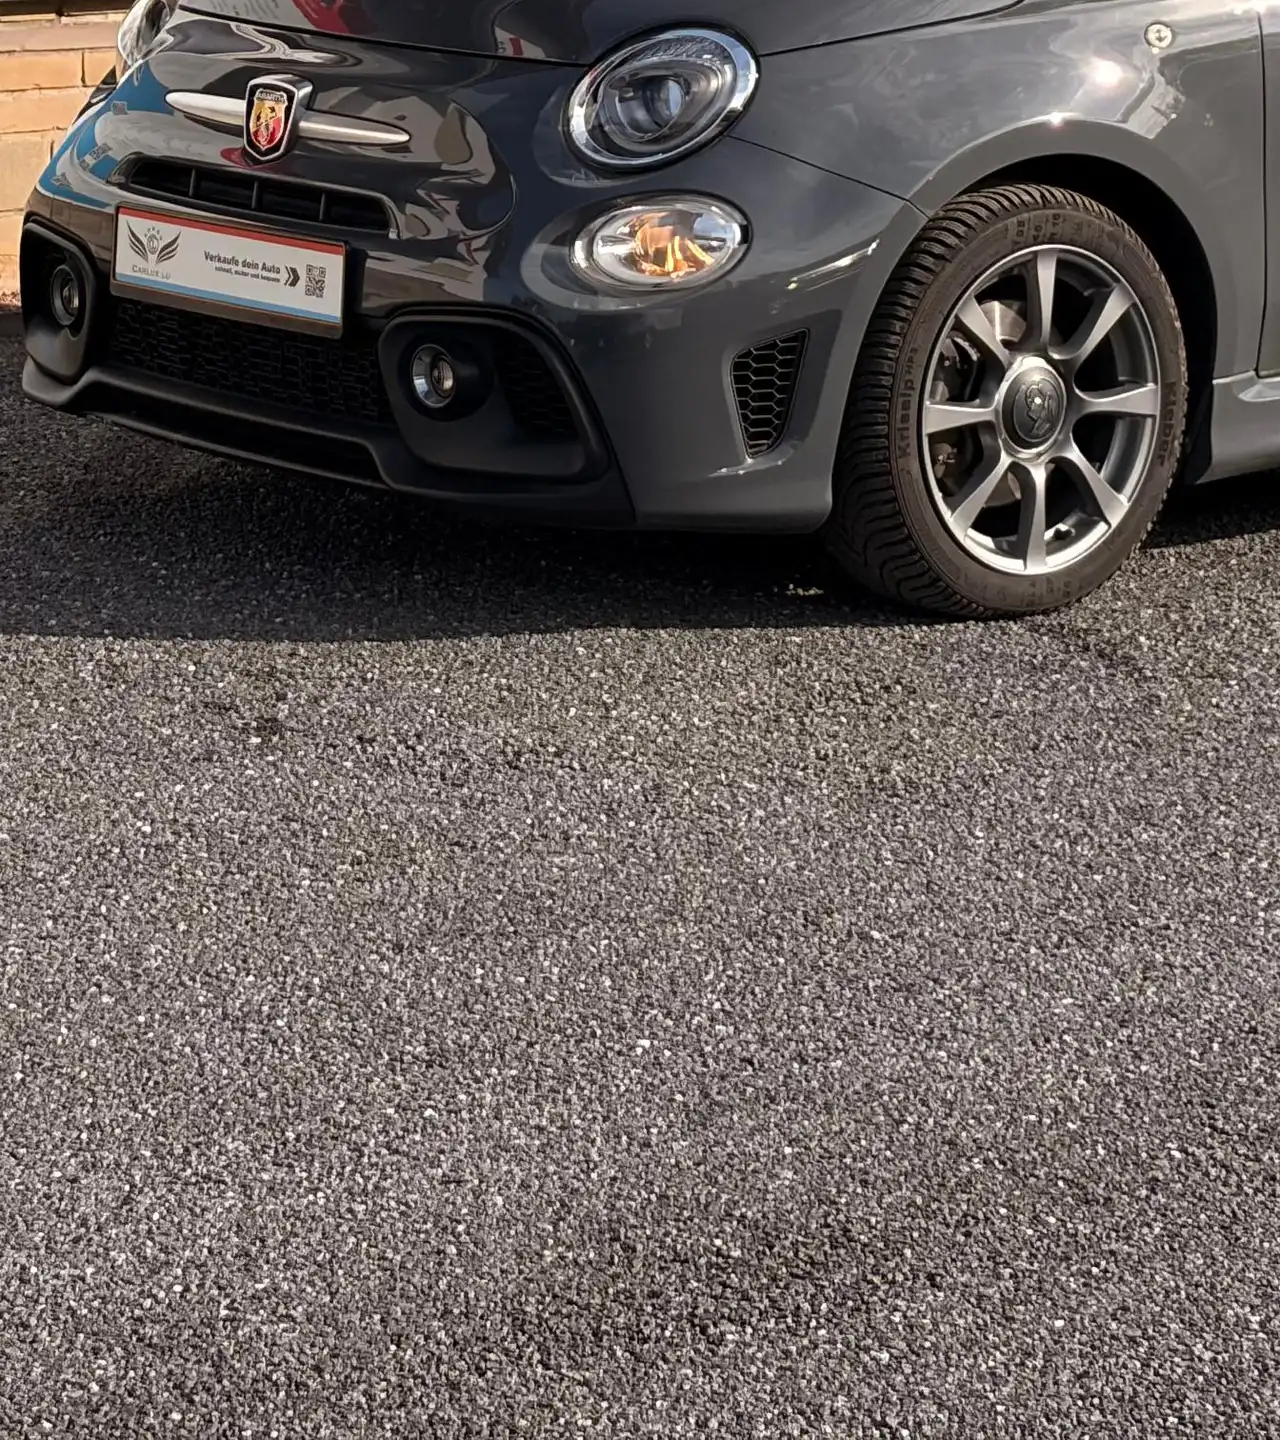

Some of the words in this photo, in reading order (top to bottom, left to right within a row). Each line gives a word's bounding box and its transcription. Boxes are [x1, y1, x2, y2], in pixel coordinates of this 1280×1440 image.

[204, 250, 240, 267] Verkaufe
[241, 258, 260, 270] dein
[261, 262, 282, 275] Auto
